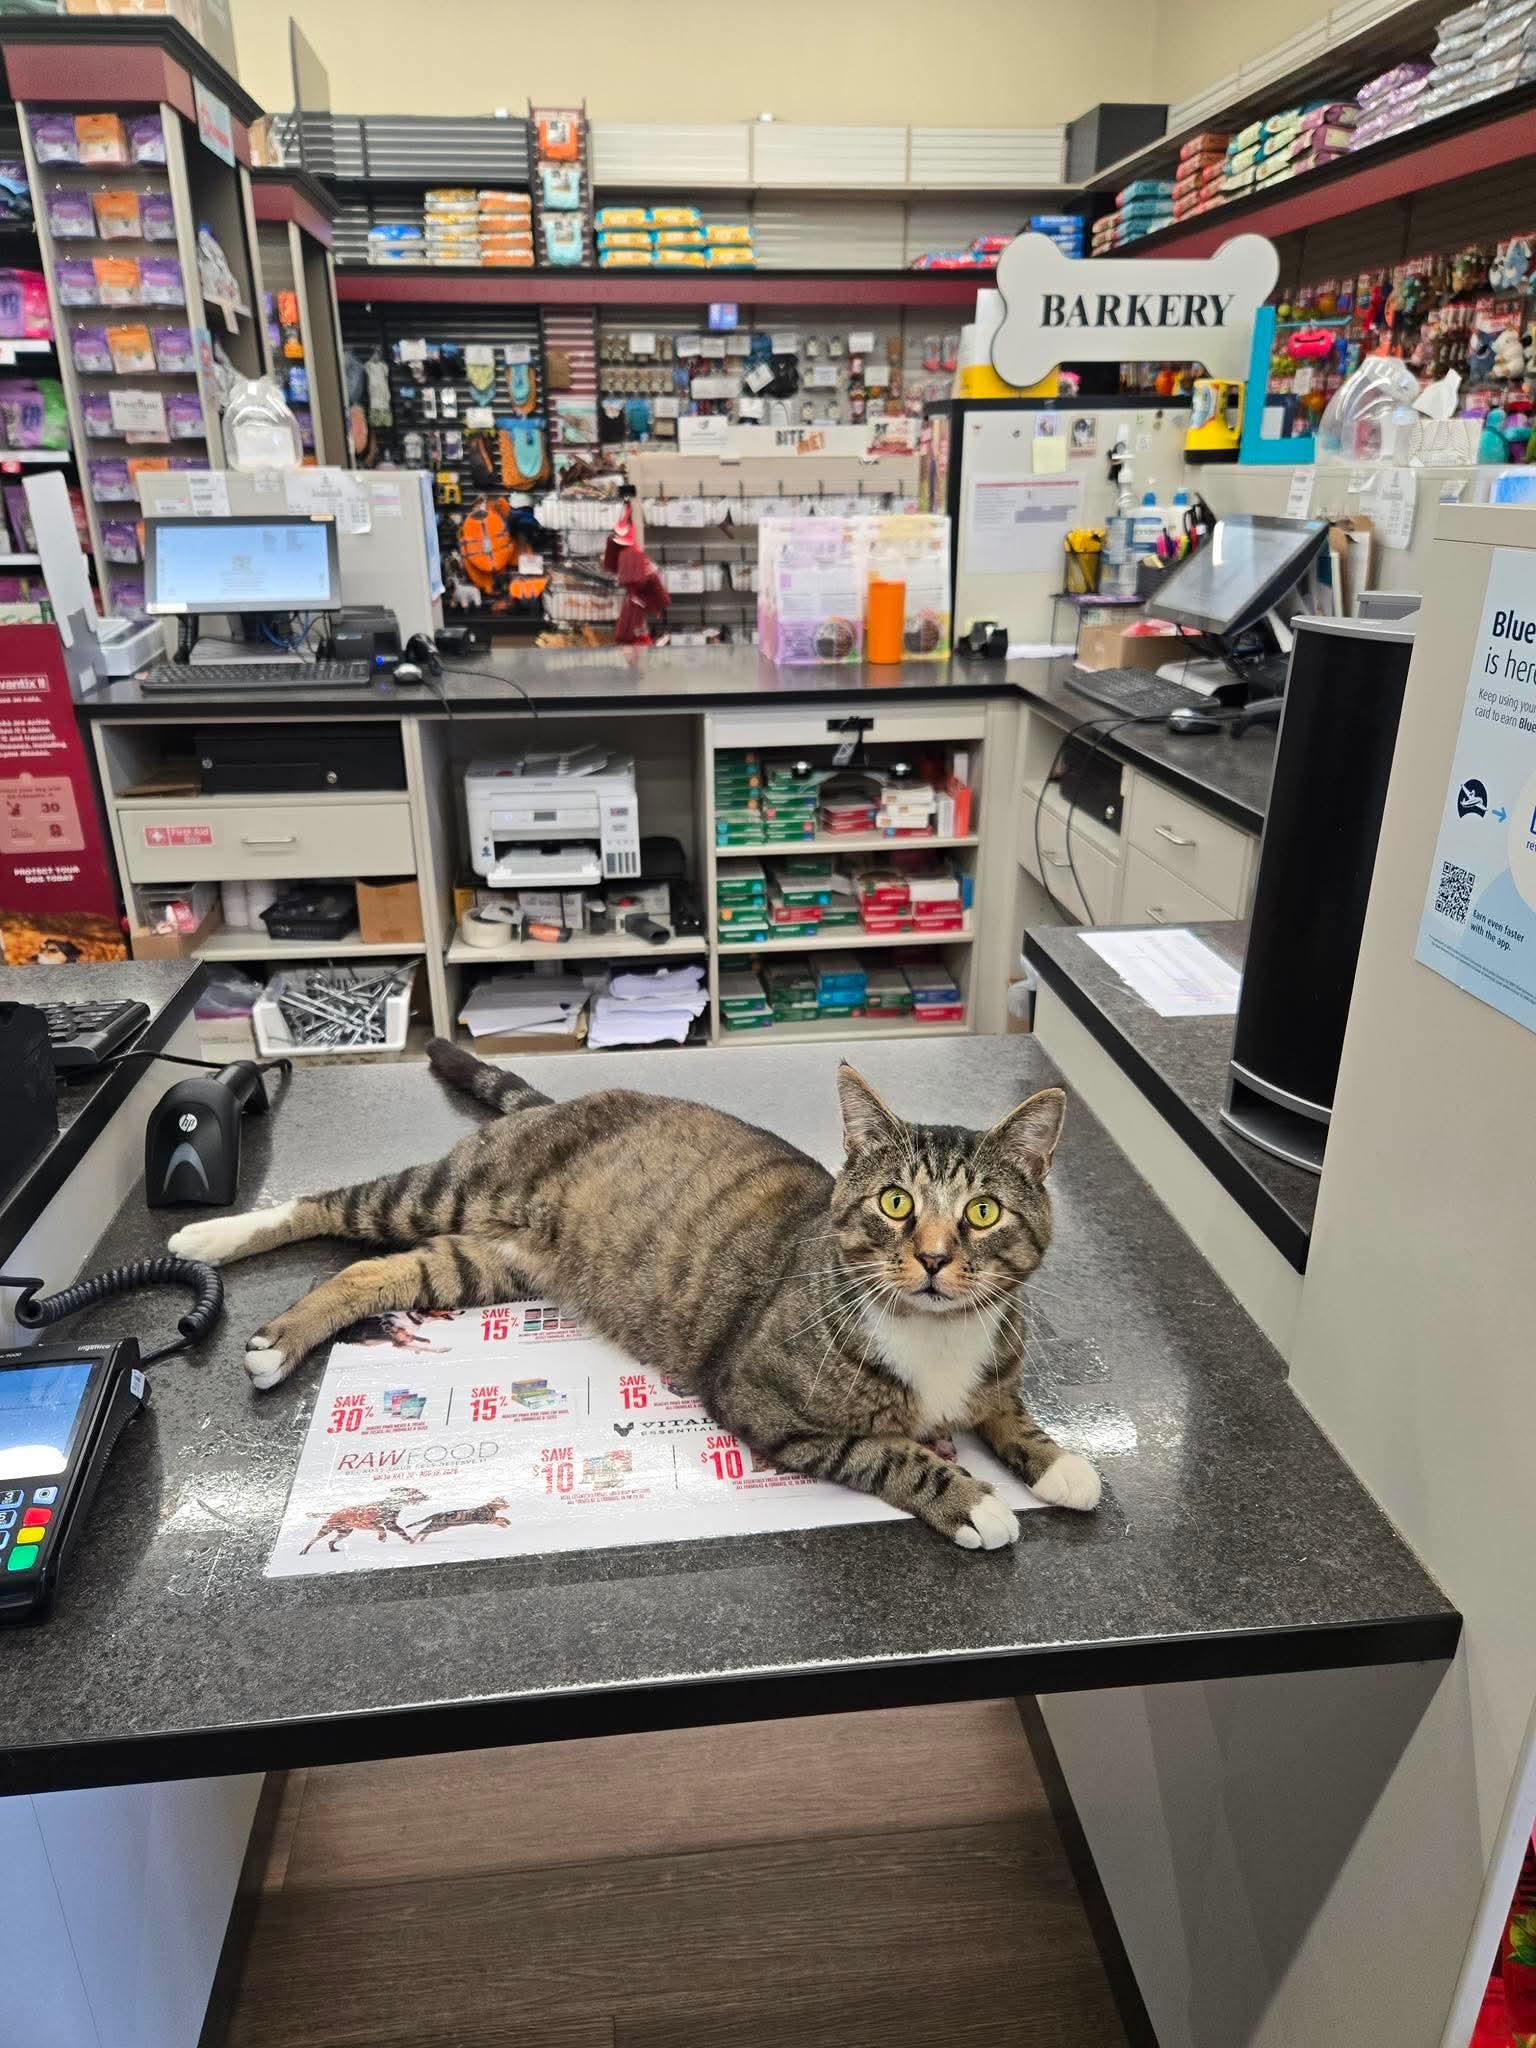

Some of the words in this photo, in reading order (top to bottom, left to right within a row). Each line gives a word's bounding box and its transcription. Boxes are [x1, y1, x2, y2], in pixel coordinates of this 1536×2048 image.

[1040, 294, 1236, 327] BARKERY
[1492, 609, 1536, 644] Blue
[1484, 646, 1500, 675] is
[1478, 687, 1498, 704] Keep
[1498, 693, 1519, 712] using
[1475, 705, 1491, 719] card
[1492, 709, 1500, 722] to
[1500, 714, 1518, 727] earn
[1518, 717, 1536, 733] Blue
[41, 802, 61, 814] 30
[1470, 922, 1484, 937] with
[1485, 930, 1496, 942] the
[1496, 938, 1512, 952] app.
[1472, 909, 1487, 924] Earn
[1487, 918, 1503, 932] even
[1504, 924, 1525, 943] faster
[180, 1113, 197, 1133] hp
[481, 1307, 512, 1320] SAVE
[480, 1317, 519, 1341] 15%
[471, 1385, 500, 1398] SAVE
[619, 1374, 647, 1387] SAVE
[334, 1393, 367, 1408] SAVE
[469, 1396, 508, 1422] 15%
[619, 1384, 657, 1410] 15%
[327, 1405, 374, 1434] 30%
[641, 1416, 716, 1429] VITAL
[541, 1447, 574, 1462] SAVE
[706, 1434, 740, 1450] SAVE
[532, 1462, 574, 1494] $10
[700, 1450, 744, 1481] $10
[4, 1490, 14, 1500] 3
